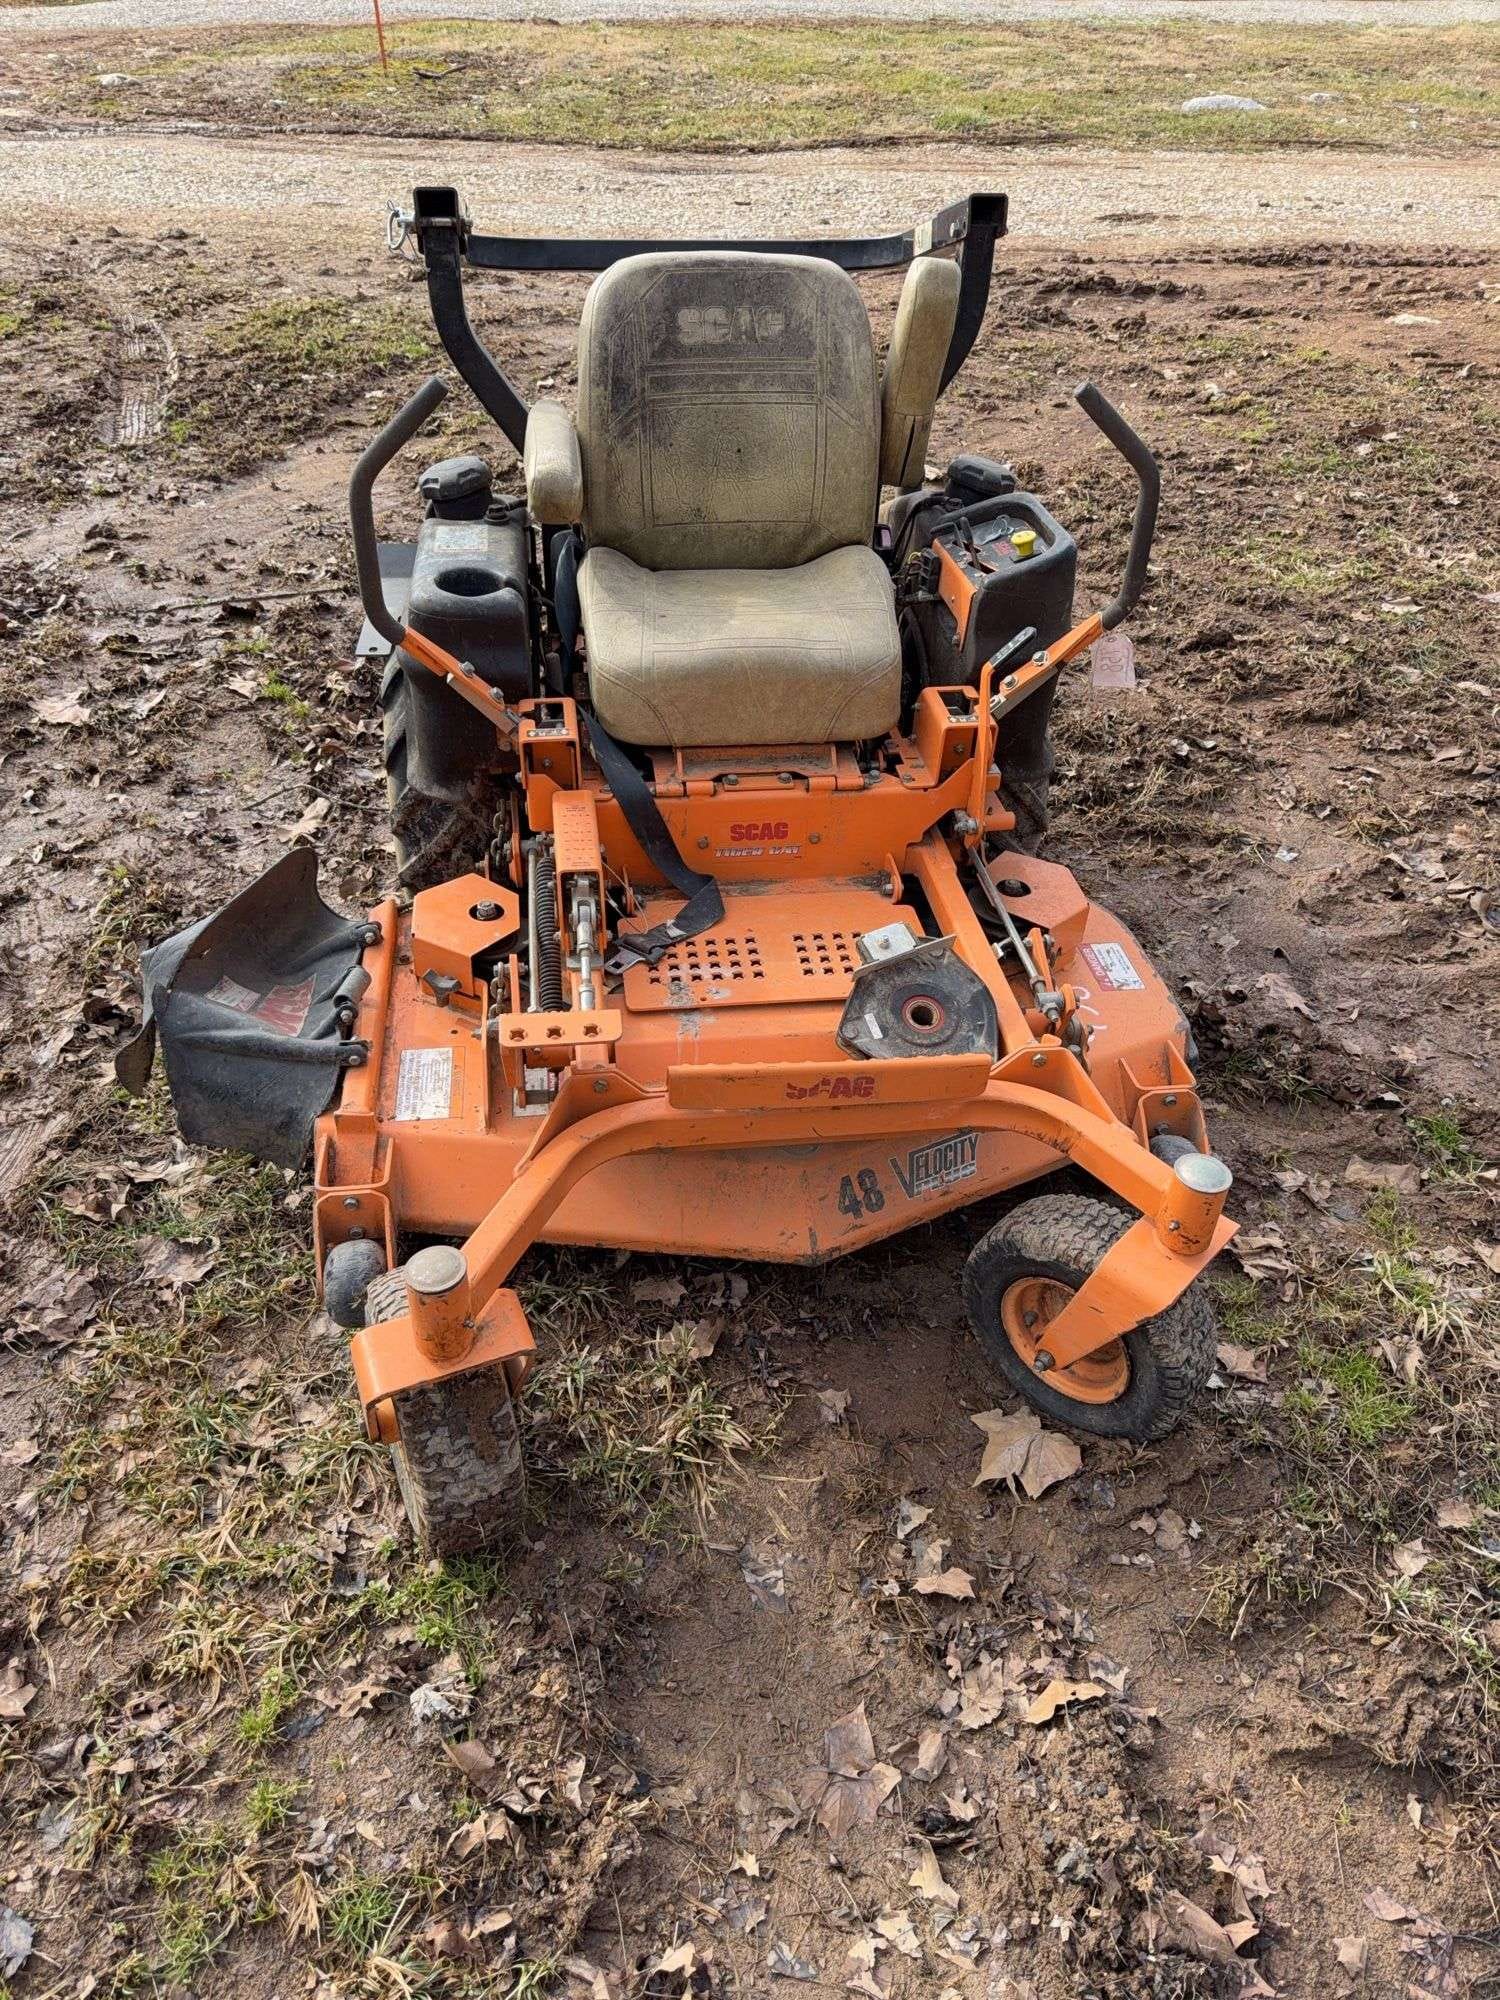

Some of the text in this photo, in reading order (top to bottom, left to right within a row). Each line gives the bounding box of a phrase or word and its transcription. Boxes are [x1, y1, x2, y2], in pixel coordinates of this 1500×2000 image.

[678, 306, 785, 345] SCAG
[730, 822, 789, 842] SCAG
[837, 1132, 981, 1220] 48 VELOCITY
